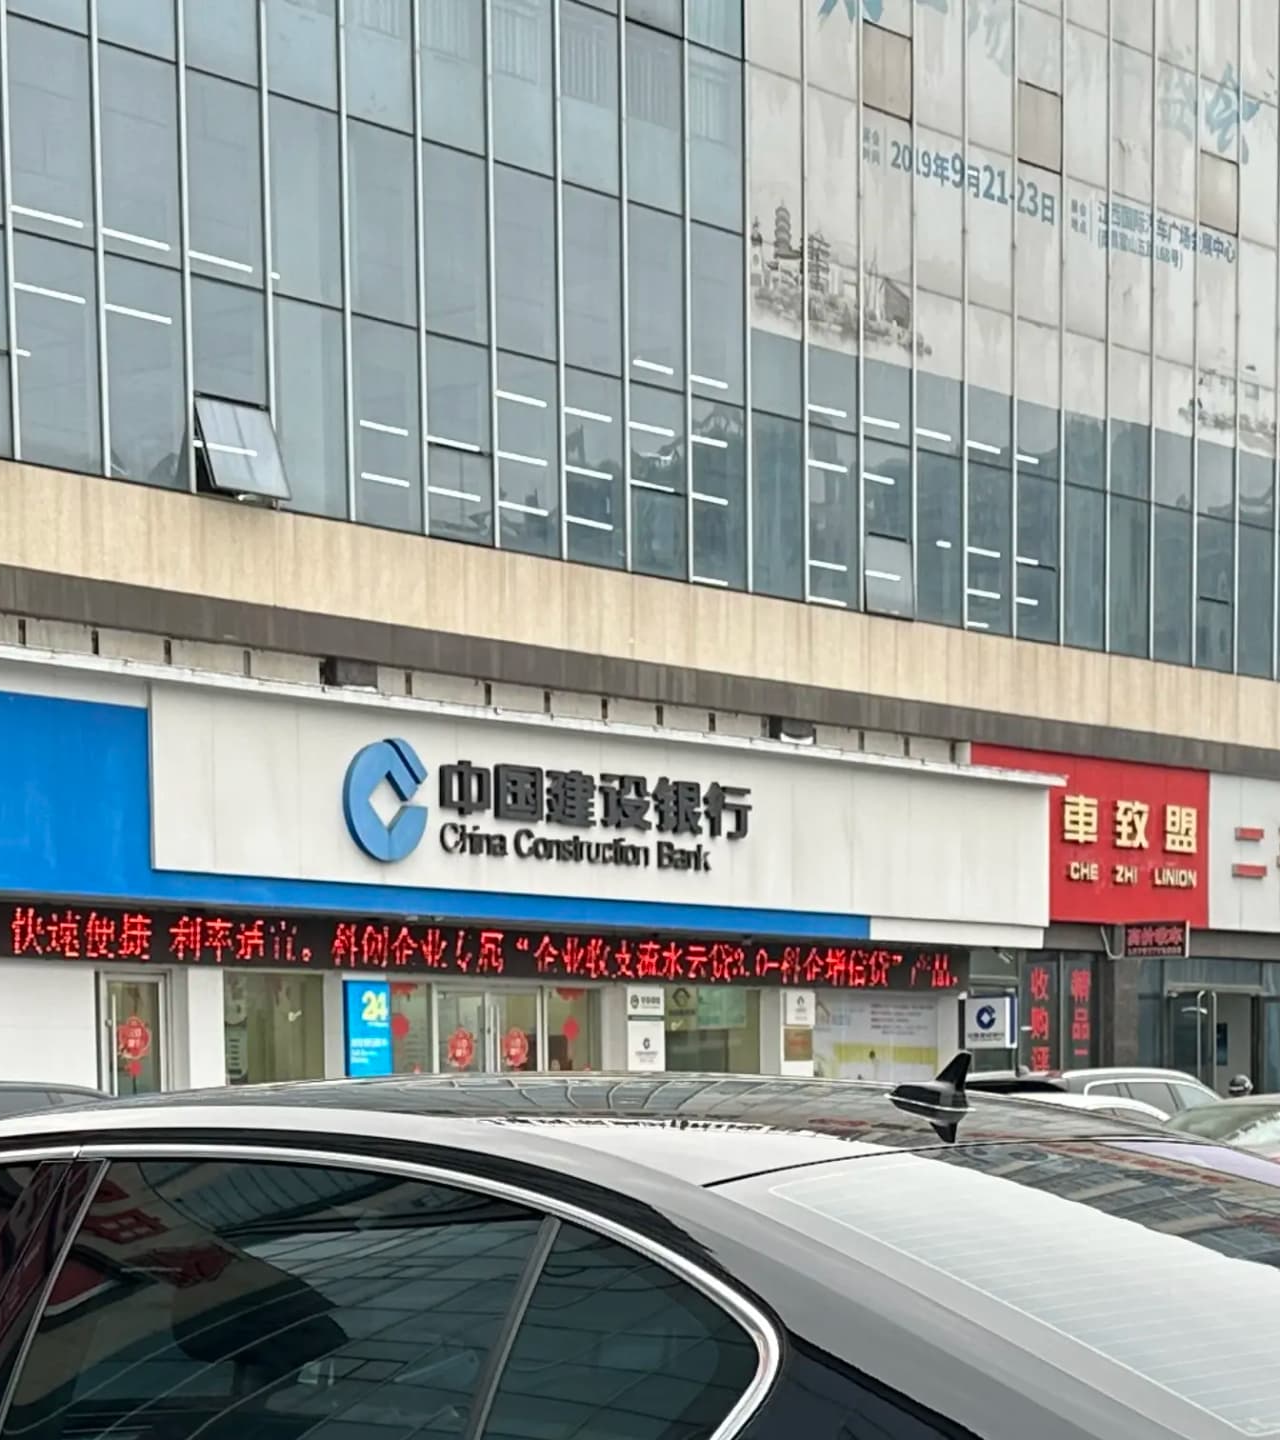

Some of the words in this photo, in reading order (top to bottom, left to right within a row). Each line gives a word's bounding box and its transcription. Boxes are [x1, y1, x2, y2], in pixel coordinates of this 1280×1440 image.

[438, 759, 753, 841] 中国建设银行
[439, 822, 508, 858] China
[513, 829, 650, 869] Construction
[656, 840, 712, 872] Bank
[1070, 861, 1099, 881] CHE
[1115, 864, 1138, 885] ZHI
[361, 990, 388, 1022] 24
